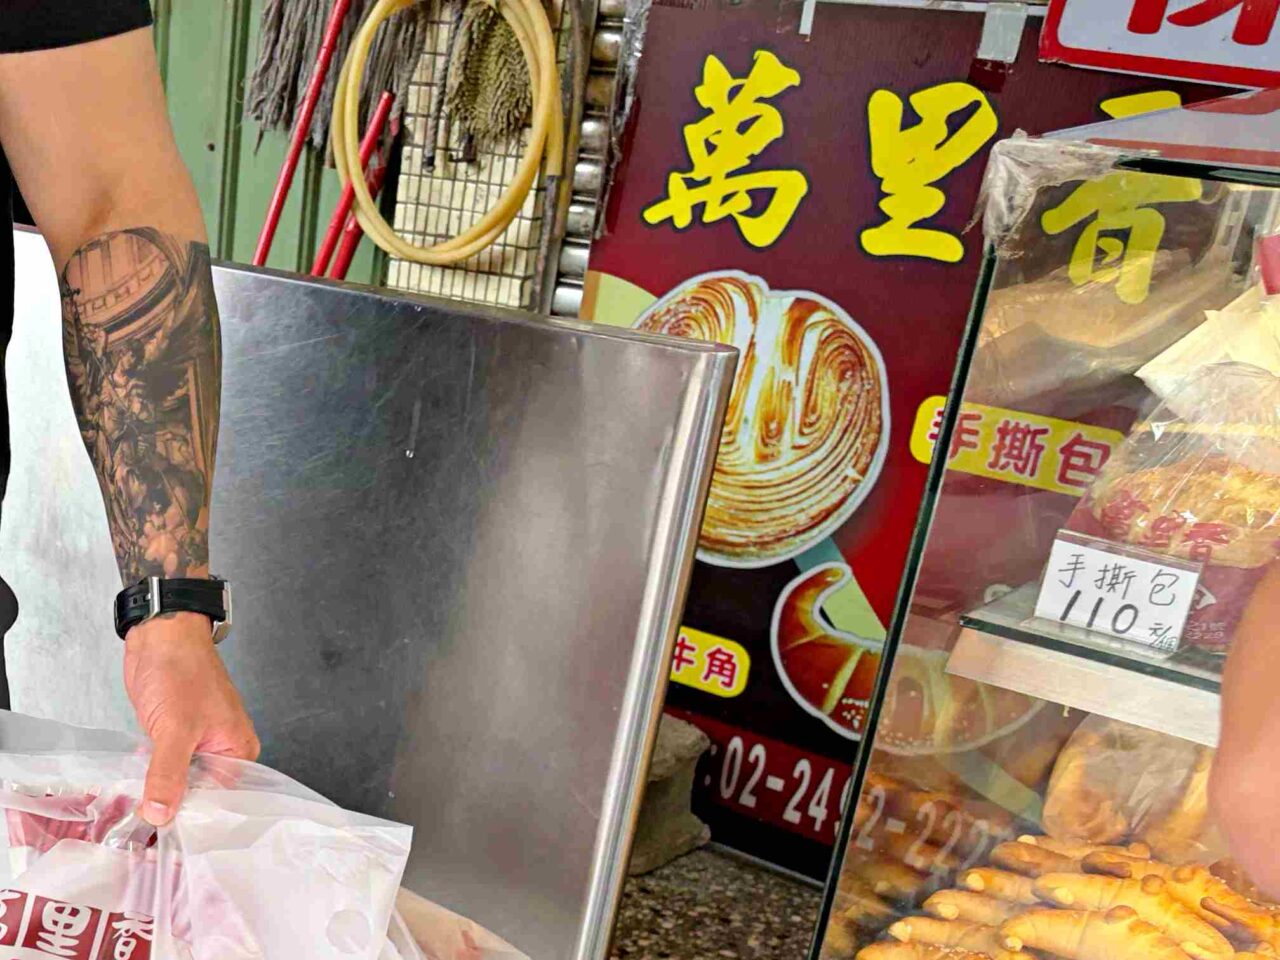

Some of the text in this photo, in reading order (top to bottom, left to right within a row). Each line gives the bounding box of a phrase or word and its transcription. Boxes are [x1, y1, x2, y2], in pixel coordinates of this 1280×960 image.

[642, 50, 1202, 304] 萬里香
[928, 406, 1112, 487] 手撕包
[1058, 553, 1180, 606] 手撕包
[1059, 590, 1139, 634] 110
